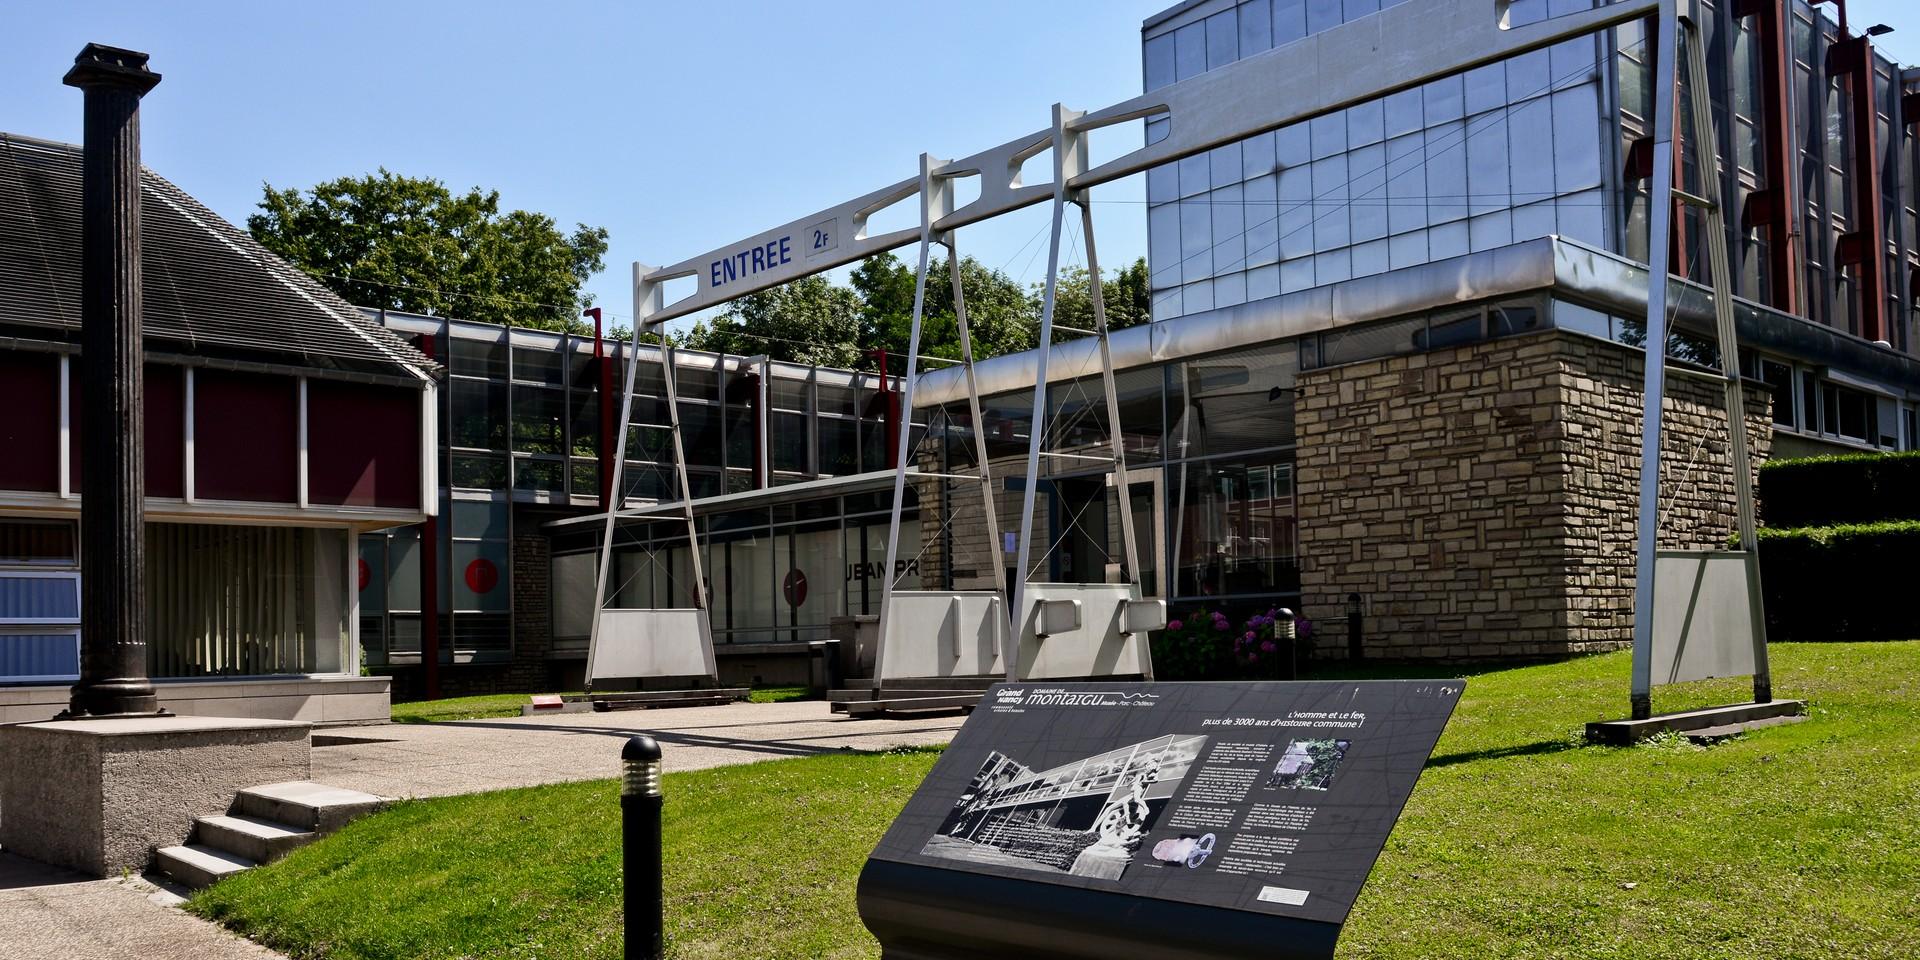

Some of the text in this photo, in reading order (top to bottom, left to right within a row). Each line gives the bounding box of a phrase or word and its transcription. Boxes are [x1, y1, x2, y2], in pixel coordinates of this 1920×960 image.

[711, 230, 829, 288] ENTREE 2F
[846, 558, 919, 582] JEAN PR
[996, 688, 1025, 697] Grand
[1328, 711, 1338, 719] et
[1221, 717, 1233, 726] de
[1233, 718, 1255, 726] 3000
[1312, 720, 1357, 729] commune
